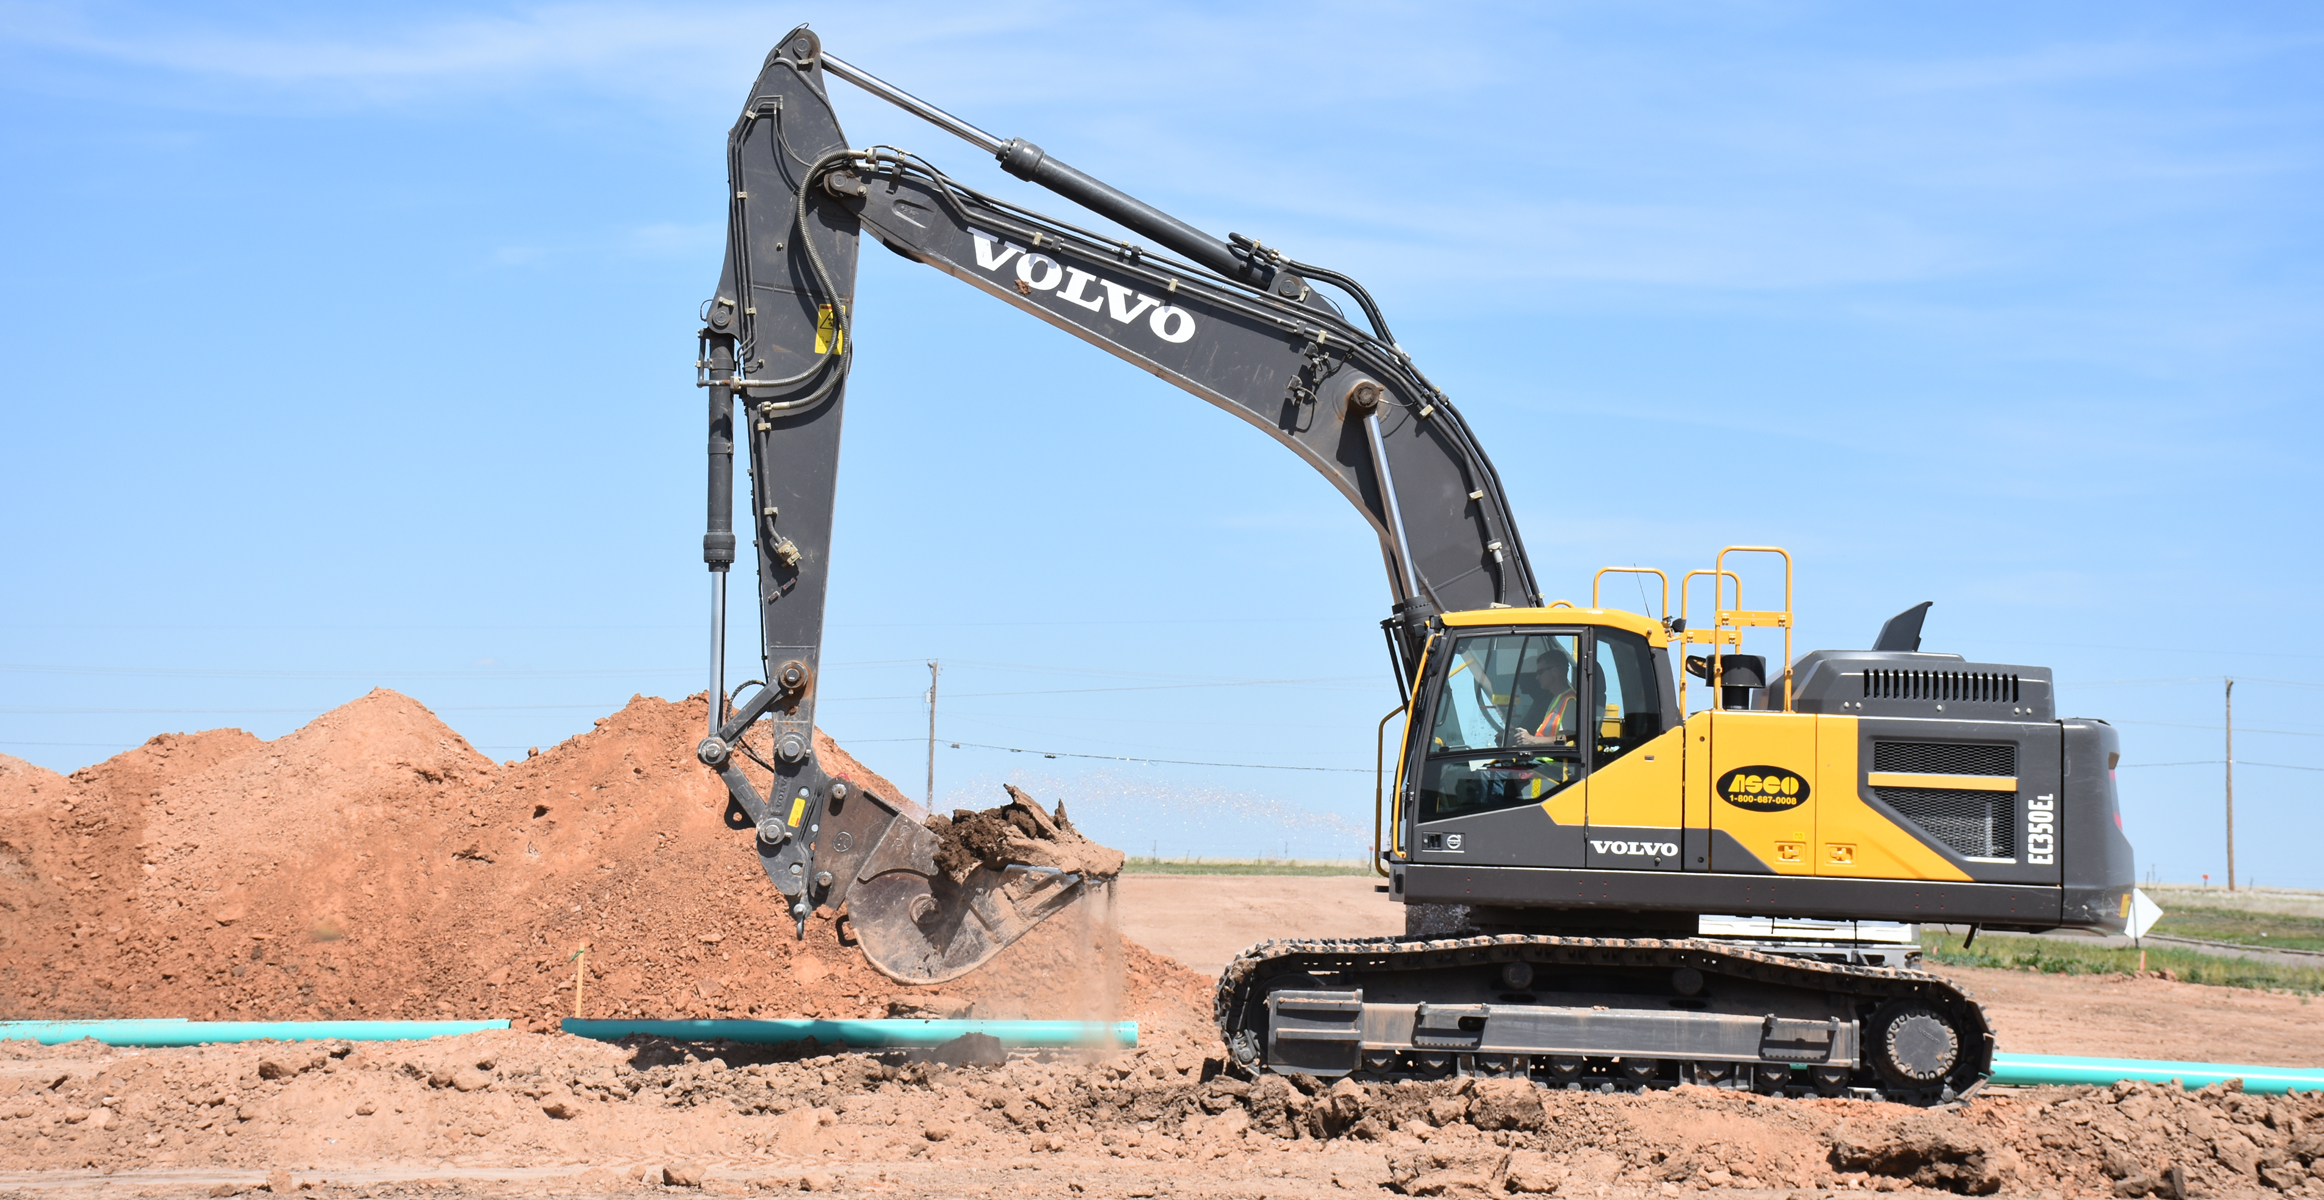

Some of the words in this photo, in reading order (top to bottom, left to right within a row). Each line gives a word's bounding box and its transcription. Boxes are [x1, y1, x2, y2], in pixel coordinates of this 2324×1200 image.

[966, 226, 1196, 343] VOLVO
[1728, 774, 1799, 795] ASCO
[1729, 795, 1797, 805] 1-800-687-0008
[1589, 840, 1679, 857] VOLVO
